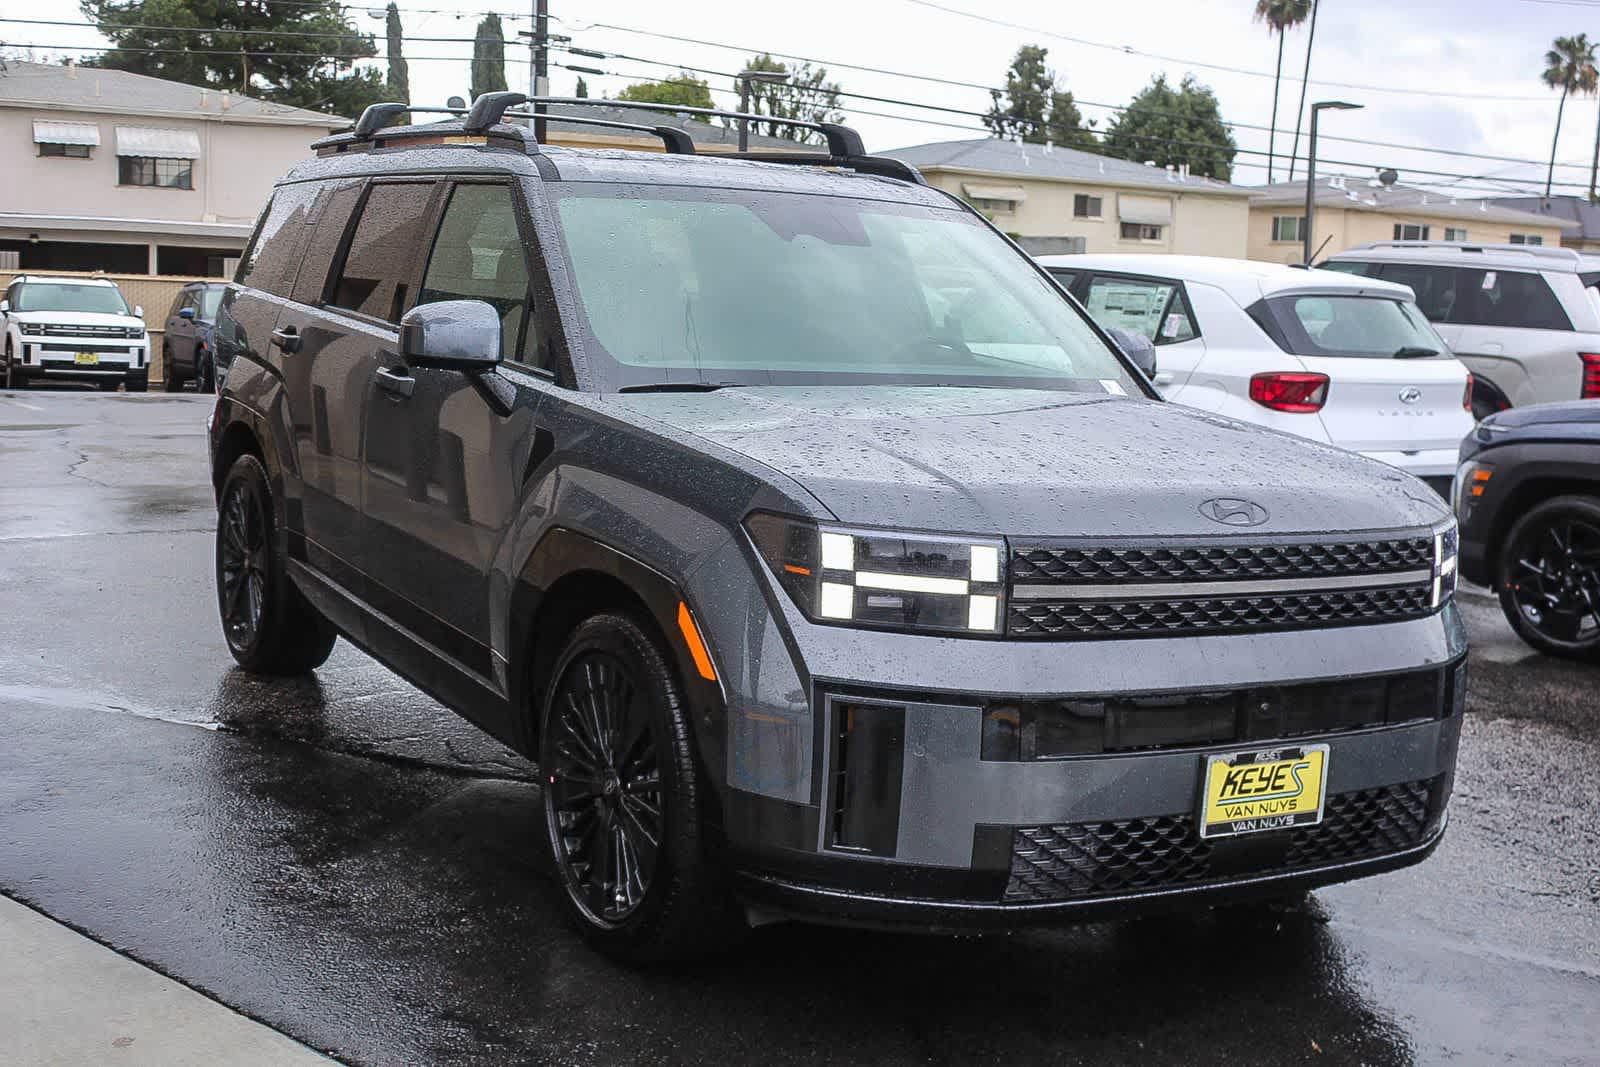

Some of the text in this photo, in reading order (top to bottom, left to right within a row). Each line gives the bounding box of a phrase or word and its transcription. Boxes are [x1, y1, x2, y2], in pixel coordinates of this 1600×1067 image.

[1219, 761, 1311, 799] KEYES
[1225, 799, 1297, 818] VAN NUYS
[1232, 815, 1295, 832] VAN NUYS
